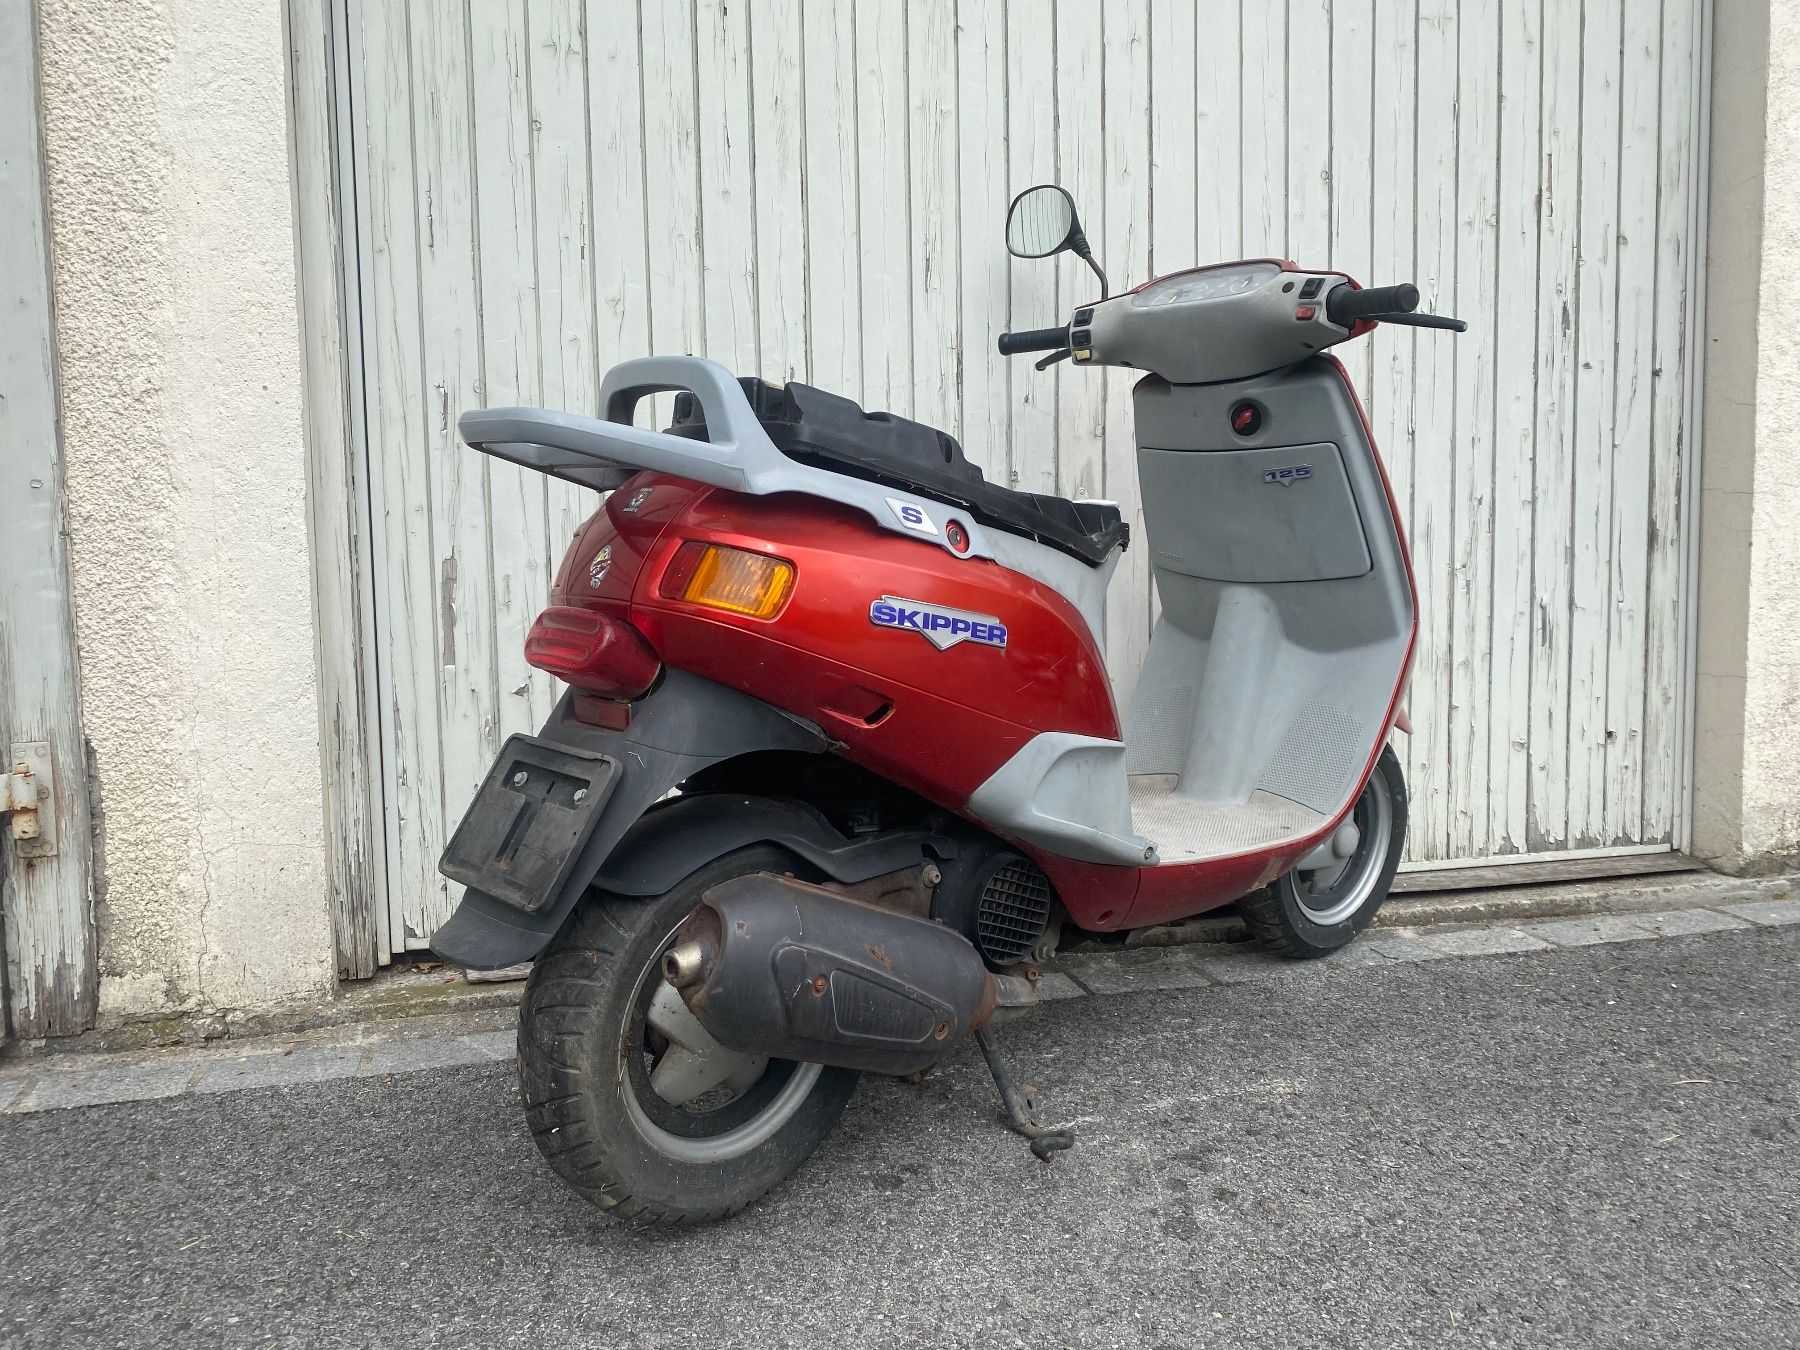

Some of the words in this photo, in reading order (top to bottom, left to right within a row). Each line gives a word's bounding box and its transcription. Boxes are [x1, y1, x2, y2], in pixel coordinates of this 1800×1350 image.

[1265, 466, 1310, 480] 125
[901, 506, 923, 525] S
[872, 602, 1007, 644] SKIPPER
